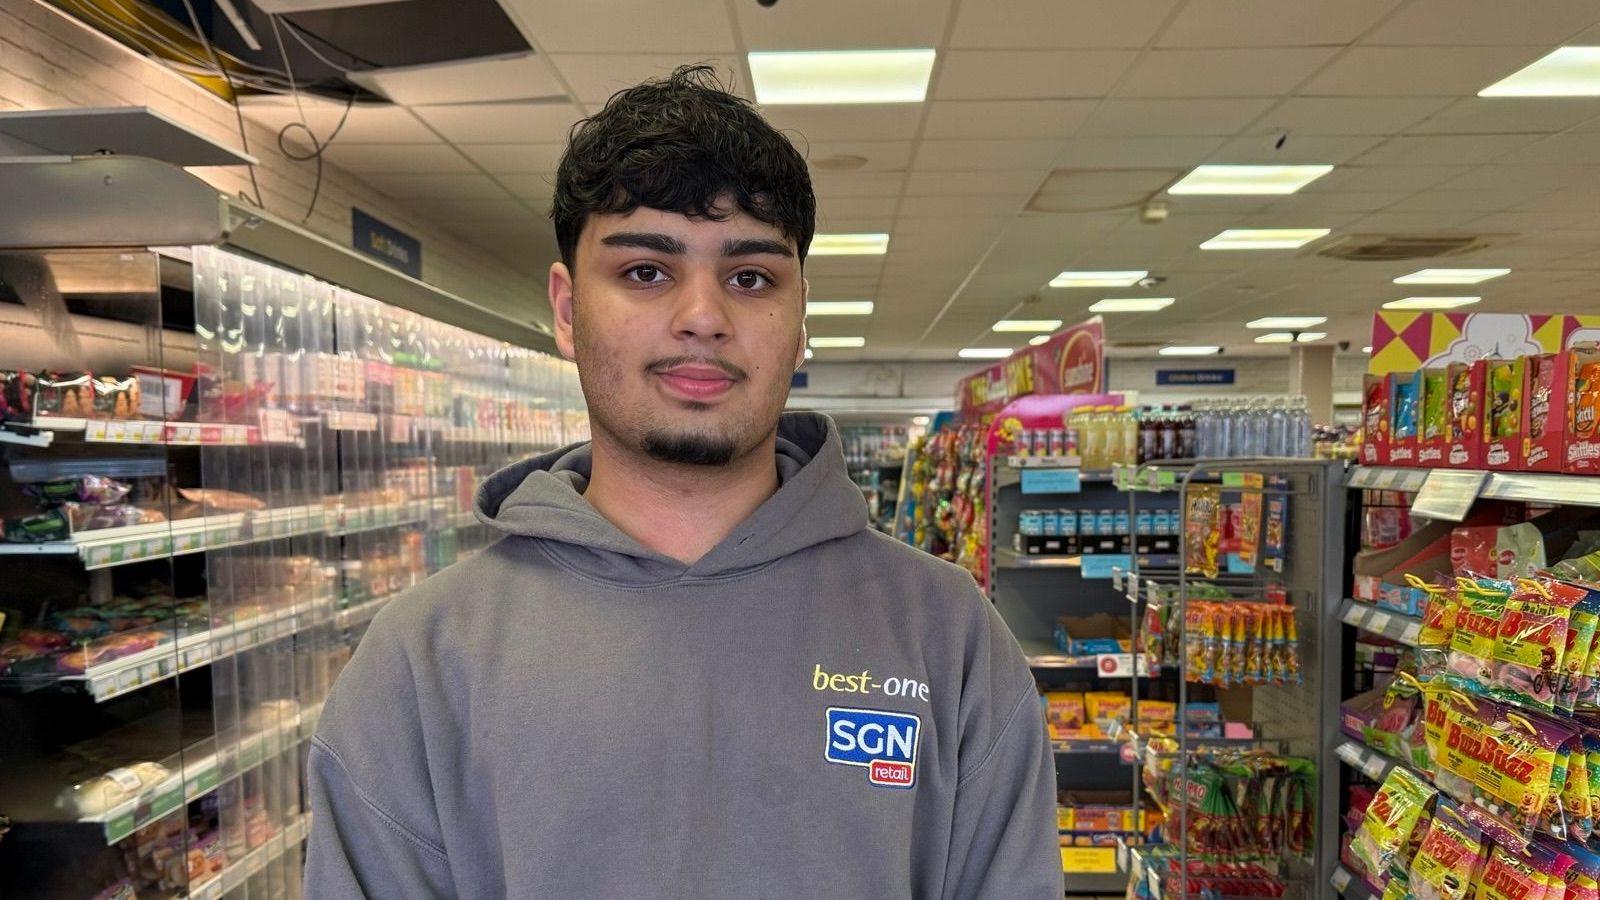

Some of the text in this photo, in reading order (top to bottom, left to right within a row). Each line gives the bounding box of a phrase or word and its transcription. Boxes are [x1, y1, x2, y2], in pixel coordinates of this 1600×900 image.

[1568, 441, 1600, 463] Skittles
[811, 664, 930, 702] best-one
[832, 719, 913, 759] SGN
[875, 767, 909, 781] retail
